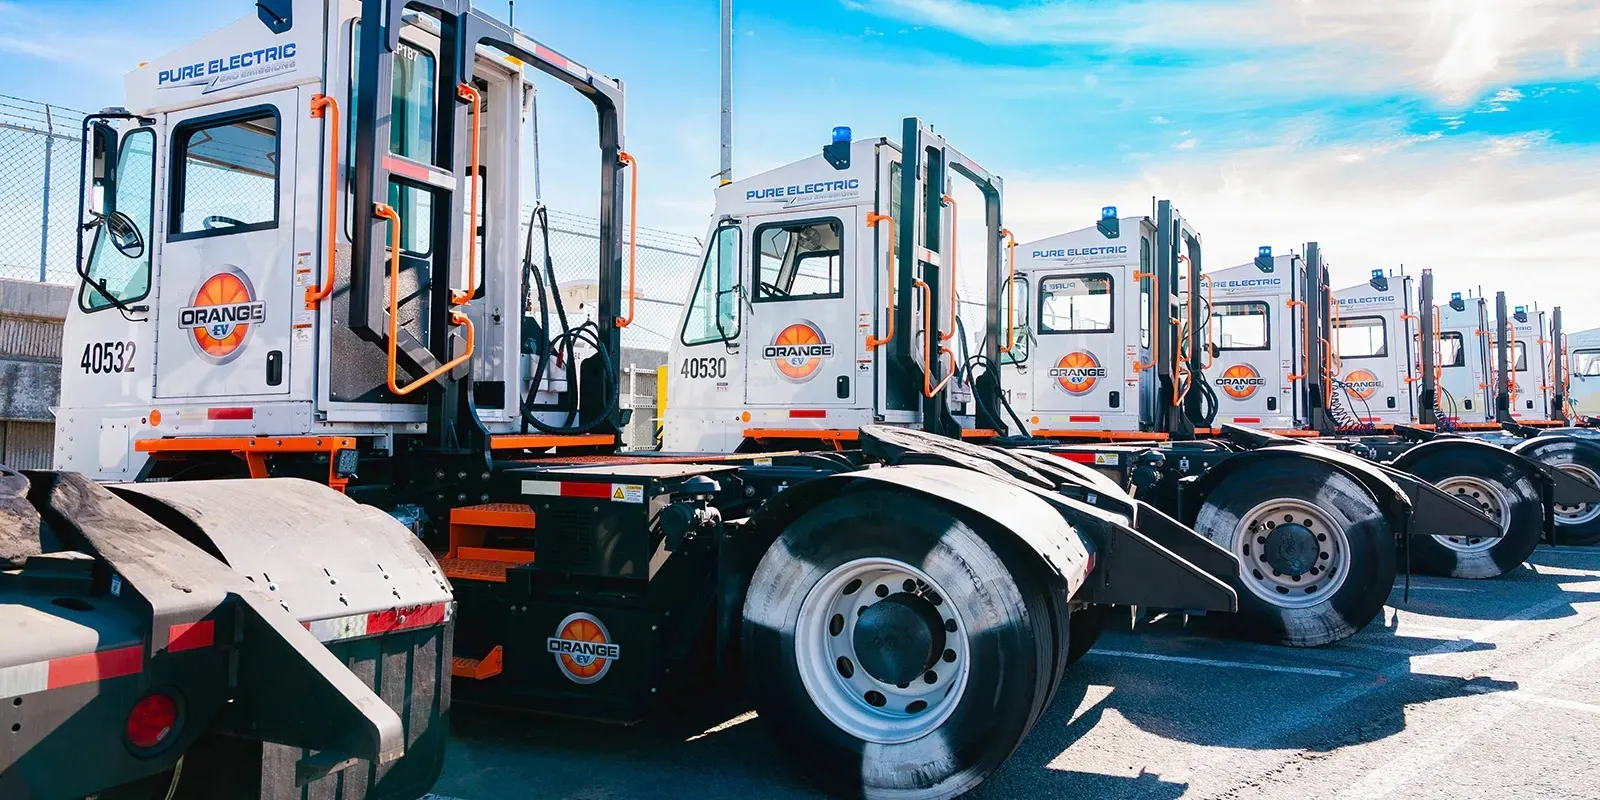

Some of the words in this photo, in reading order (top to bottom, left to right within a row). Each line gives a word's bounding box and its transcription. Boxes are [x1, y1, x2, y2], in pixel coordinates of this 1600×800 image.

[393, 43, 418, 62] P187
[159, 63, 204, 85] PURE
[208, 43, 296, 75] ELECTRIC
[746, 187, 784, 200] PURE
[787, 179, 859, 196] ELECTRIC
[1032, 249, 1065, 258] PURE
[1067, 245, 1127, 256] ELECTRIC
[1229, 278, 1281, 287] ELECTRIC
[1347, 295, 1395, 304] ELECTRIC
[181, 304, 263, 325] ORANGE
[212, 324, 229, 336] EV
[80, 341, 136, 374] 40532
[764, 345, 832, 358] ORANGE
[680, 357, 727, 379] 40530
[1049, 368, 1106, 377] ORANGE
[549, 640, 618, 657] ORANGE
[576, 655, 590, 663] EV
